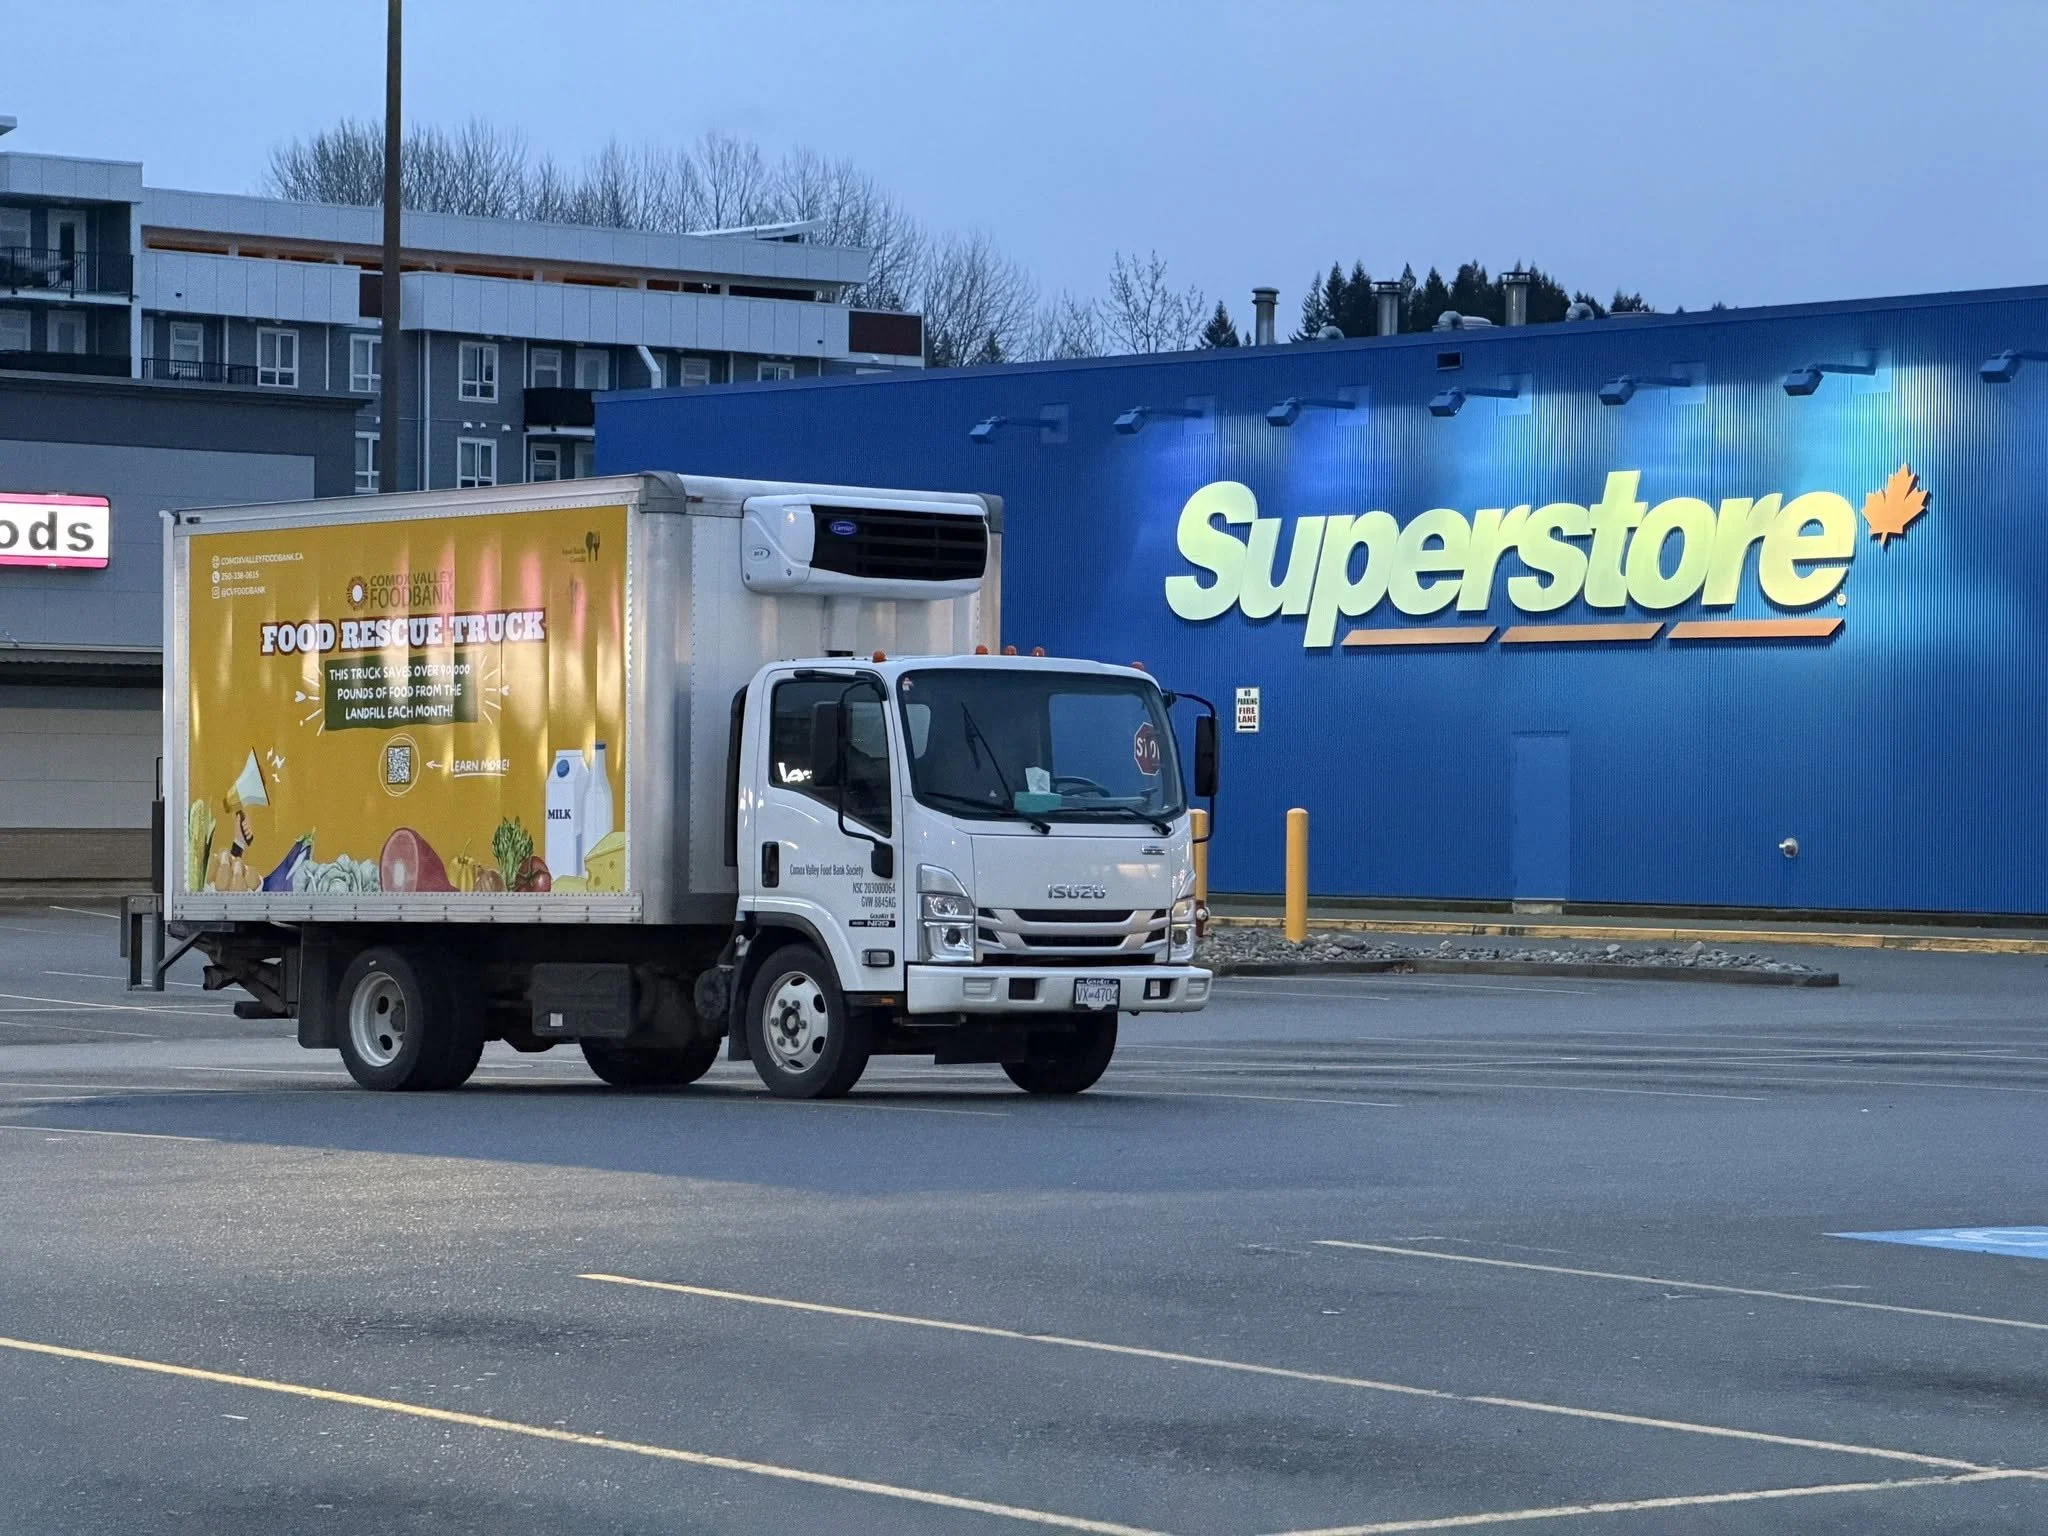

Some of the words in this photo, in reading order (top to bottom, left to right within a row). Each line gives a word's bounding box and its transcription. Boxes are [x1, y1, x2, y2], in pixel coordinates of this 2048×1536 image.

[1165, 470, 1857, 647] Superstore
[370, 574, 410, 587] COMOX
[413, 571, 453, 585] VALLEY
[370, 585, 453, 609] FOODBANK
[262, 623, 335, 653] FOOD
[341, 617, 443, 649] RESCUE
[451, 611, 545, 644] TRUCK
[329, 668, 348, 680] THIS
[351, 666, 381, 680] TRUCK
[383, 665, 411, 679] SAVES
[414, 665, 438, 677] OVER
[338, 688, 374, 700] POUNDS
[376, 687, 387, 699] OF
[389, 686, 413, 698] FOOD
[415, 684, 442, 697] FROM
[445, 684, 462, 696] THE
[1244, 689, 1251, 697] NO
[345, 706, 385, 720] LANDFILL
[388, 705, 414, 718] EACH
[415, 704, 453, 718] MONTH!
[1239, 707, 1256, 715] FIRE
[1238, 715, 1256, 723] LANE
[451, 759, 479, 772] LEARN
[481, 759, 510, 772] MORE!
[547, 809, 572, 820] MILK
[790, 864, 805, 875] Comox
[806, 864, 819, 878] Valley
[820, 864, 832, 875] Food
[833, 864, 845, 875] Bank
[846, 864, 864, 879] Society
[853, 883, 863, 894] NSC
[1047, 884, 1106, 899] ISUZU
[861, 897, 873, 908] GVW
